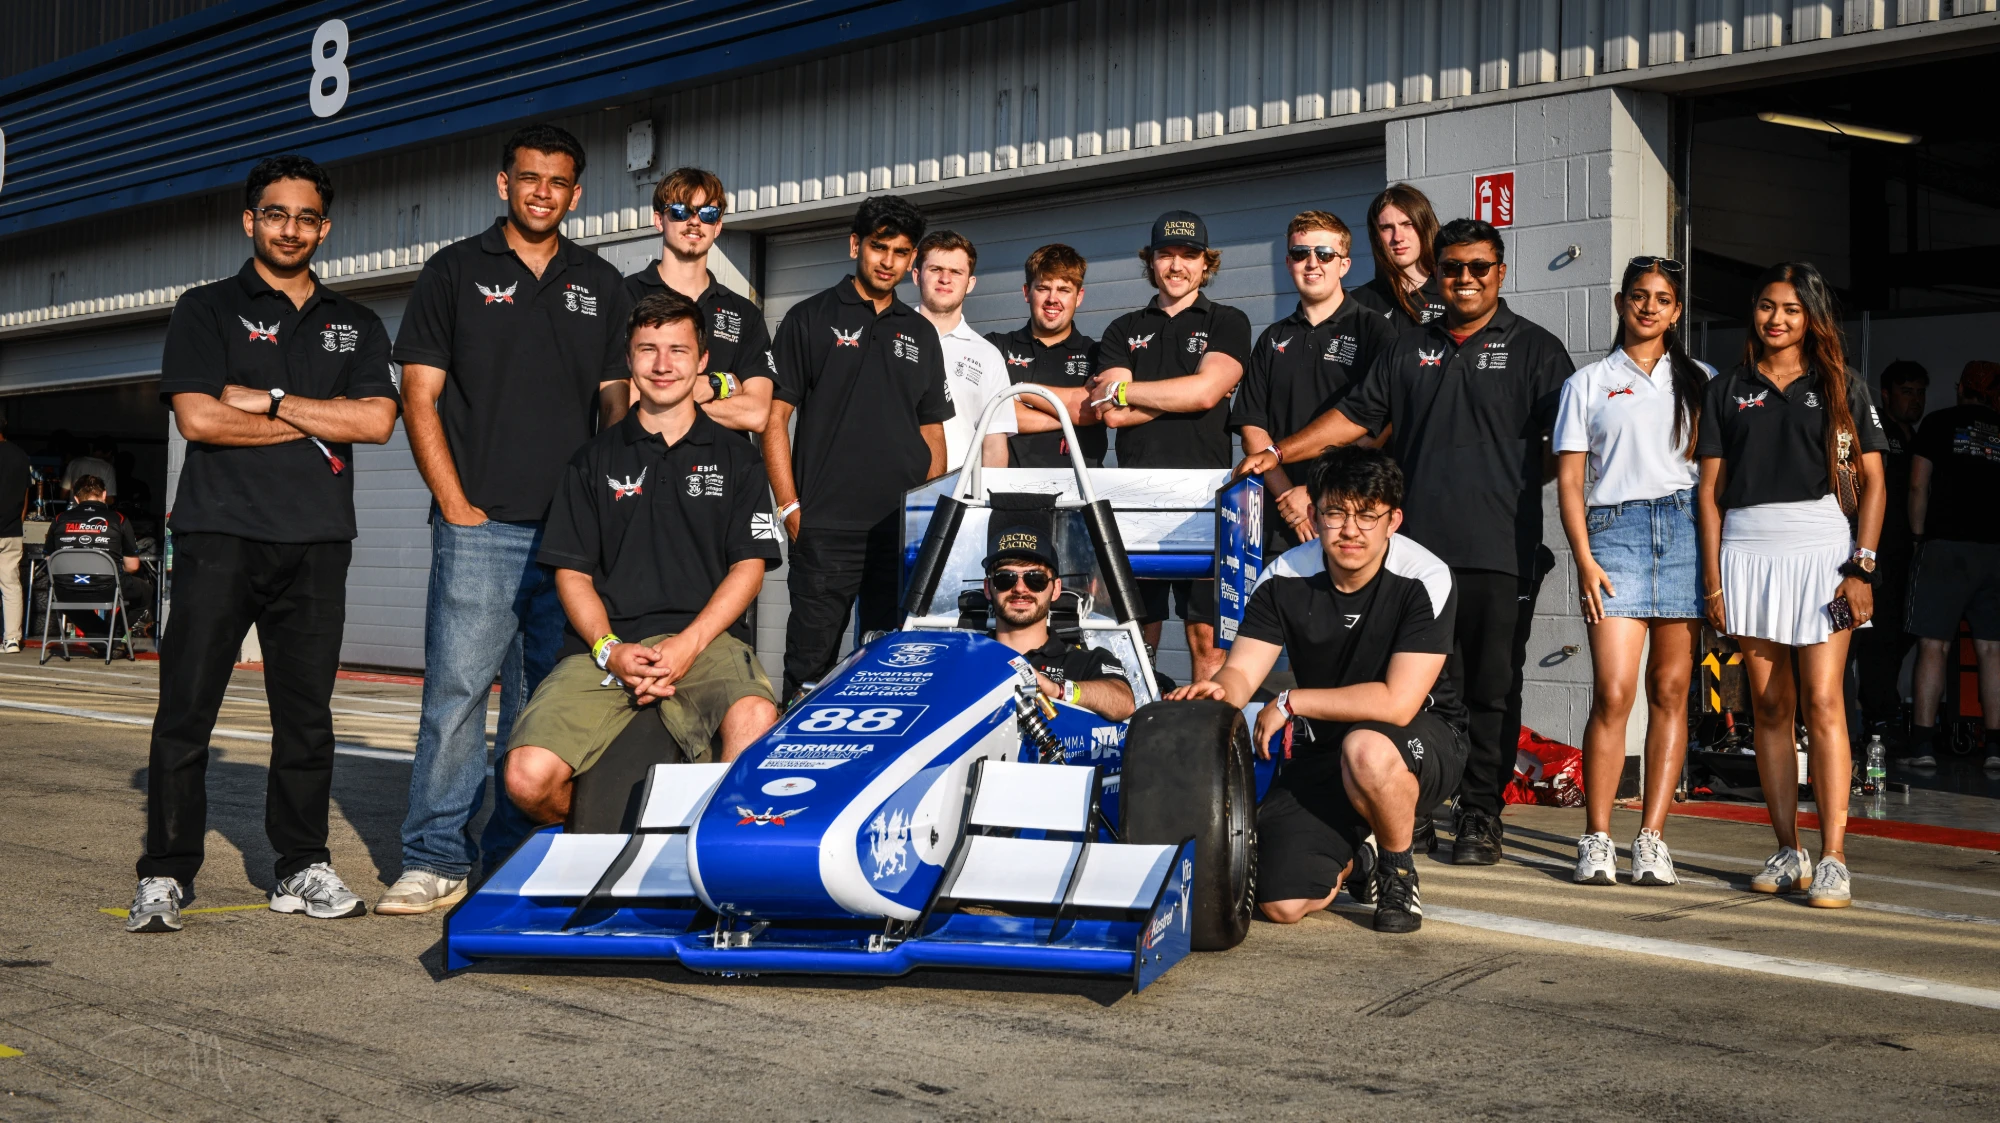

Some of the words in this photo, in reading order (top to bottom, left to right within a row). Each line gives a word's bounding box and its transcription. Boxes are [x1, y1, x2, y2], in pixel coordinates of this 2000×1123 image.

[309, 19, 349, 117] 8
[1163, 221, 1195, 230] ARCTOS
[1164, 228, 1195, 237] RACING
[1248, 490, 1261, 549] 88
[998, 532, 1037, 544] ARCTOS
[997, 541, 1037, 552] RACING
[797, 707, 903, 732] 88
[774, 743, 875, 752] FORMULA
[1056, 735, 1085, 750] AMMA
[767, 750, 868, 759] STUDENT
